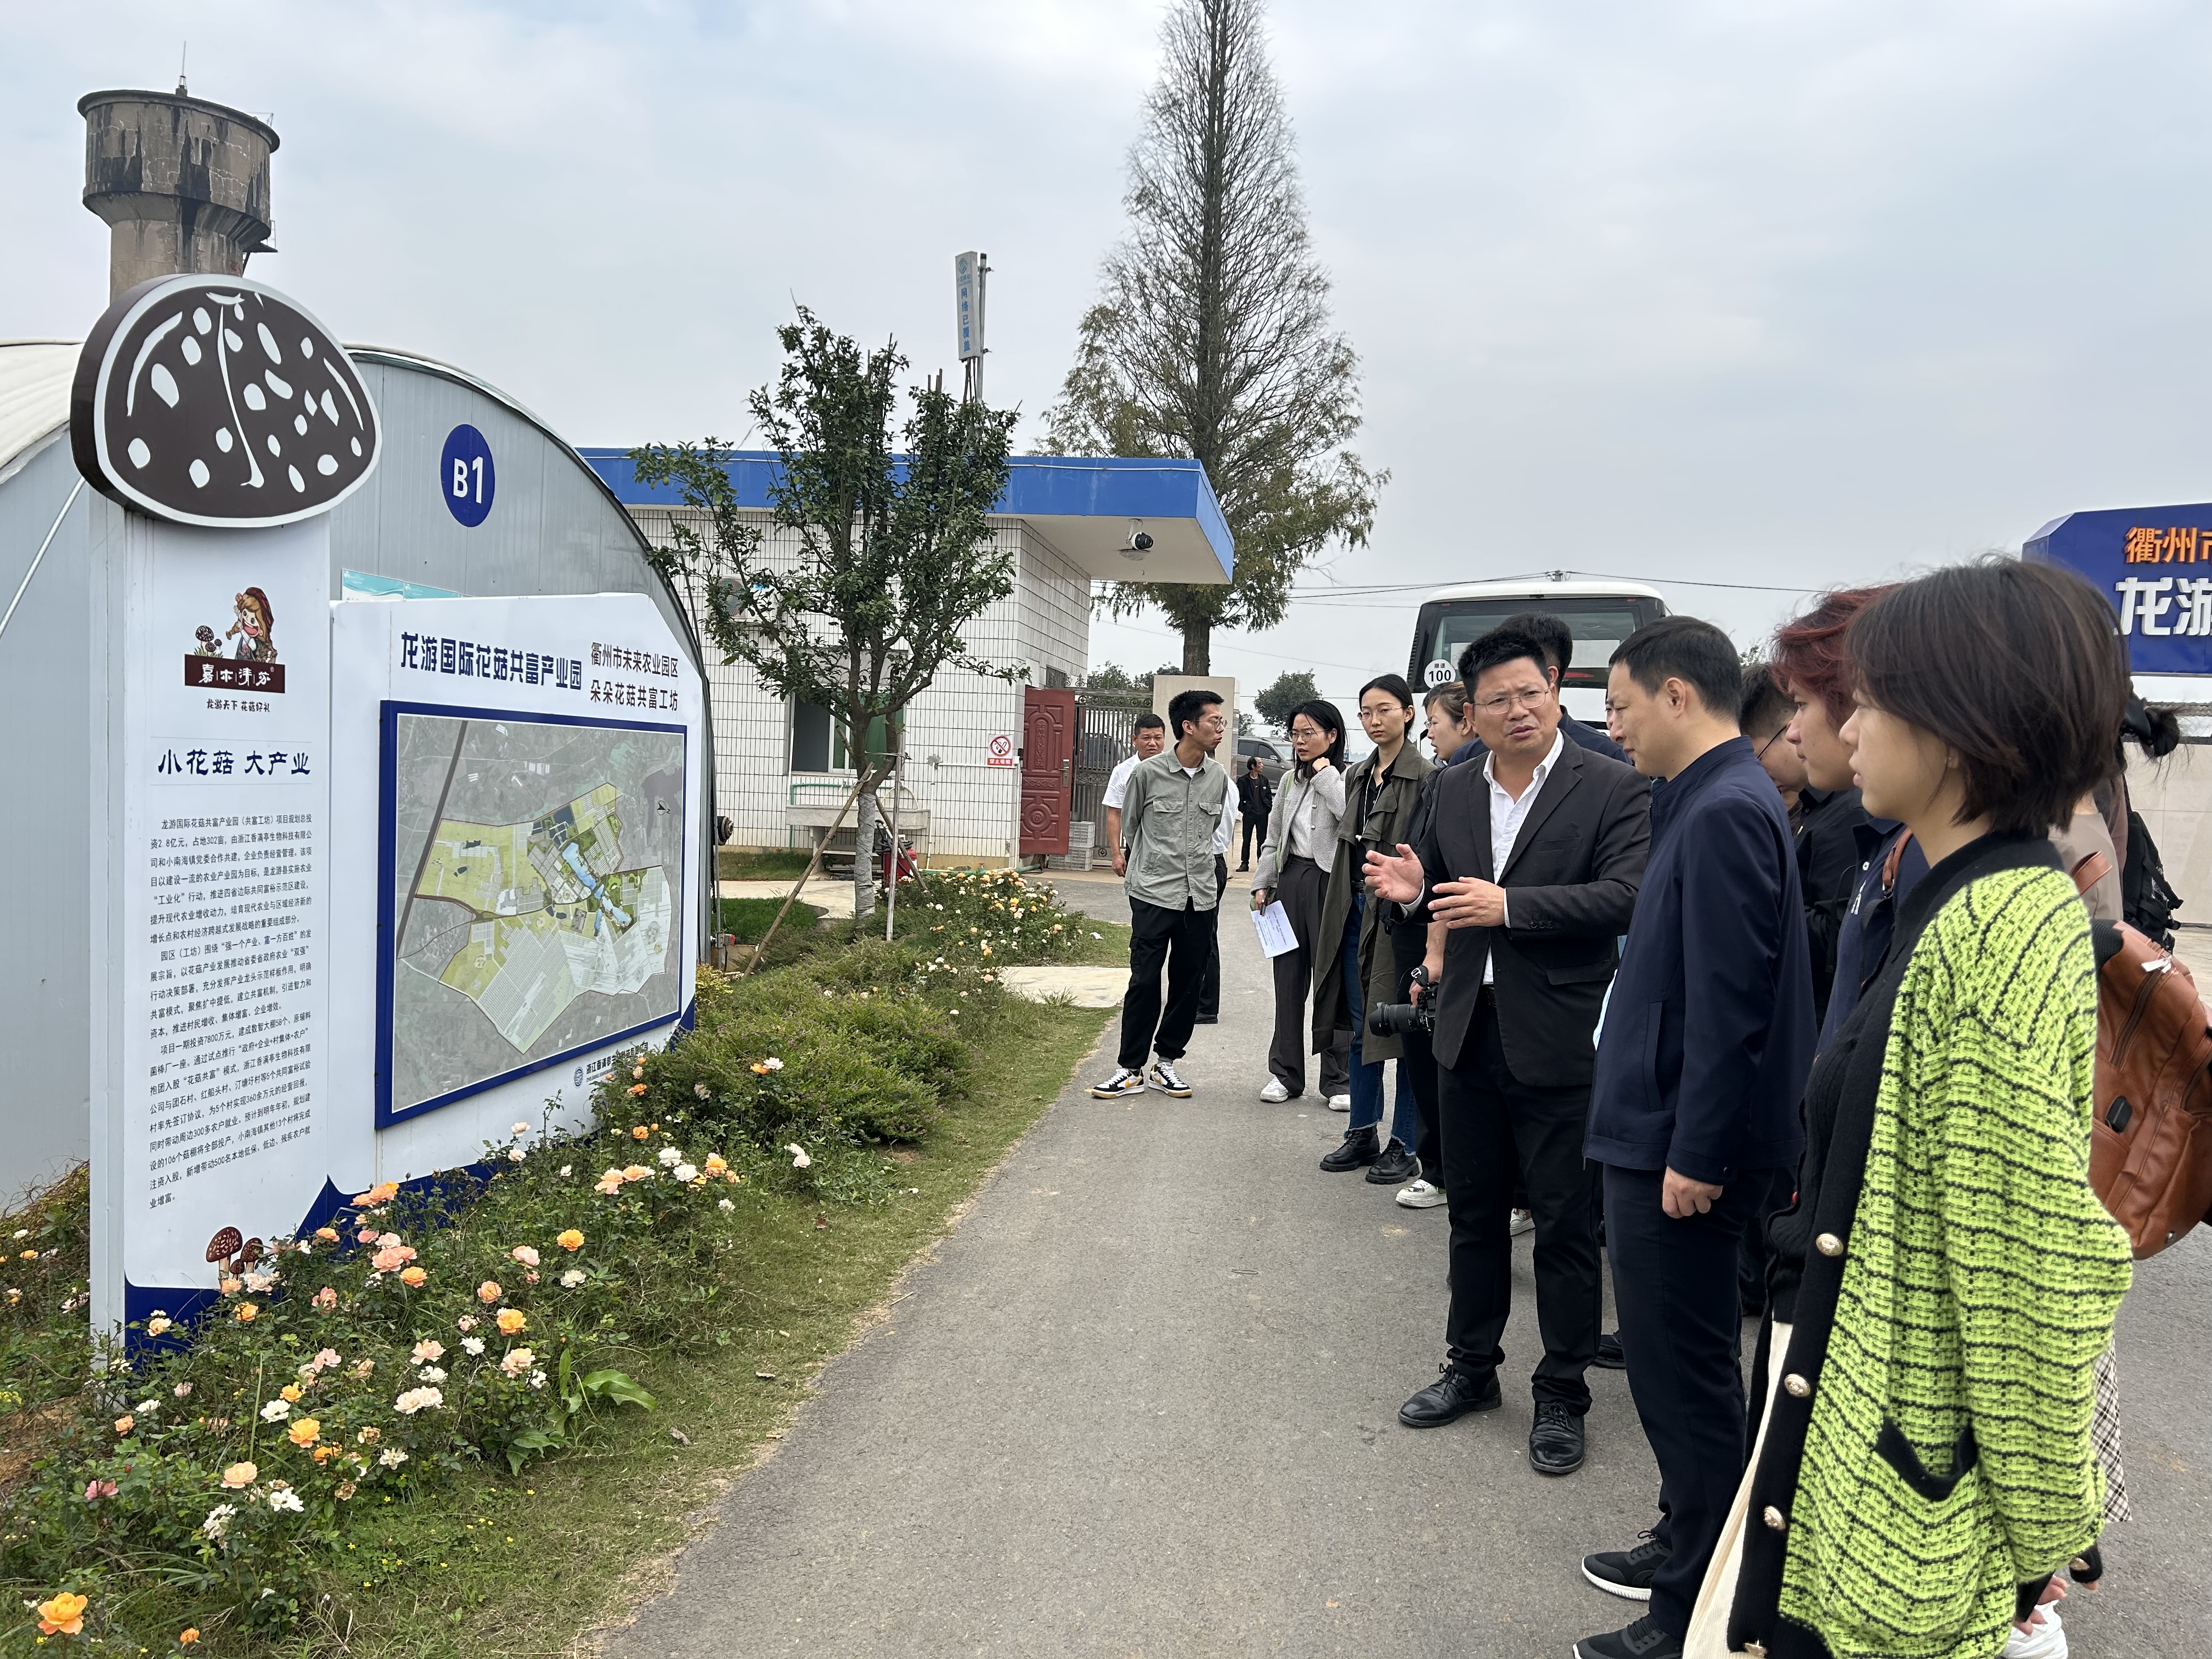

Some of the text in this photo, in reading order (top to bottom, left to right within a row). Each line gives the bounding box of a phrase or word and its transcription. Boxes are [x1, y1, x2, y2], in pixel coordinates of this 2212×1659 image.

[961, 287, 970, 352] 网络已覆盖
[453, 456, 483, 504] B1
[400, 631, 582, 690] 龙游国际花菇共富产业园
[591, 642, 678, 679] 衢州市未来农业园区
[1429, 670, 1452, 682] 100
[590, 679, 678, 712] 朵朵花菇共富工坊
[158, 748, 311, 776] 小花菇 大产业
